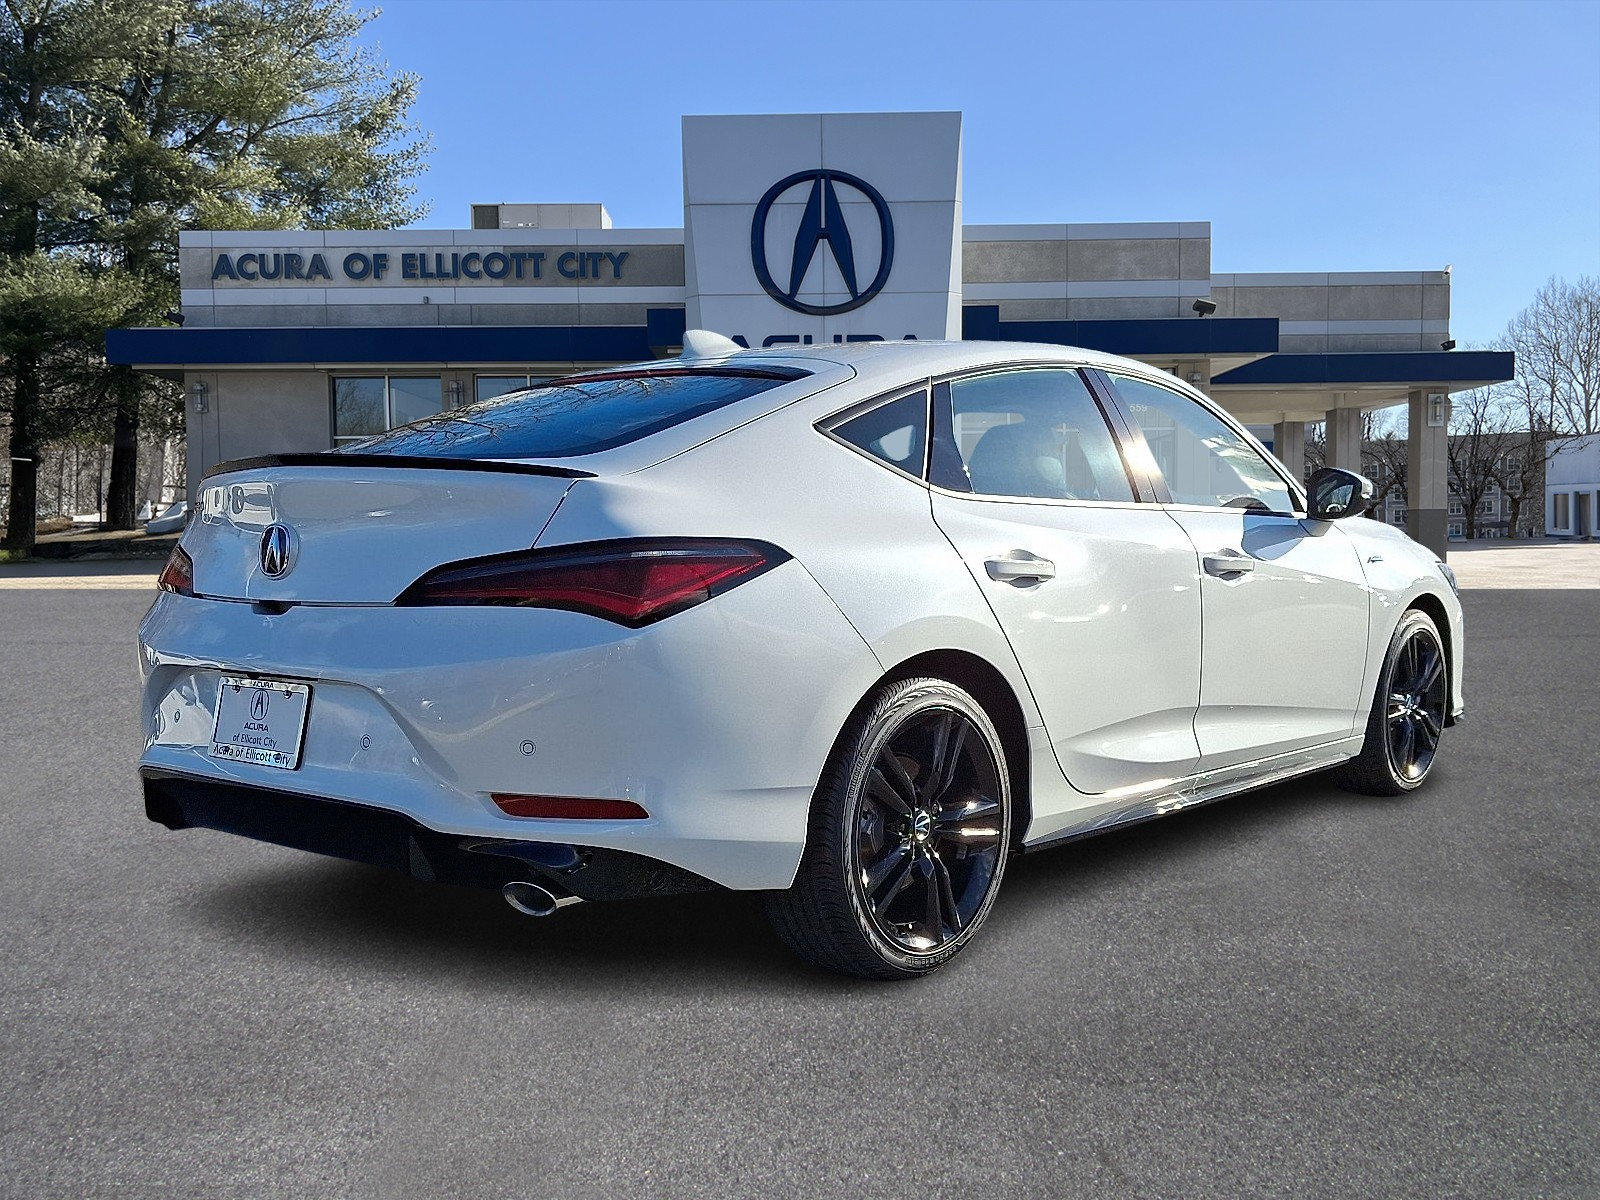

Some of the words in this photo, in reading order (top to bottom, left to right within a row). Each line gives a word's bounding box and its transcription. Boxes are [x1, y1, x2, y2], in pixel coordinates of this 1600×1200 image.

[212, 253, 332, 280] ACURA
[343, 252, 389, 280] OF
[402, 252, 546, 280] ELLICOTT
[557, 251, 629, 280] CITY
[252, 680, 274, 688] ACURA
[244, 721, 269, 732] ACURA
[232, 733, 241, 742] of
[241, 733, 262, 745] Ellicott
[264, 736, 277, 749] City
[236, 748, 244, 757] of
[246, 748, 272, 762] Ellicott
